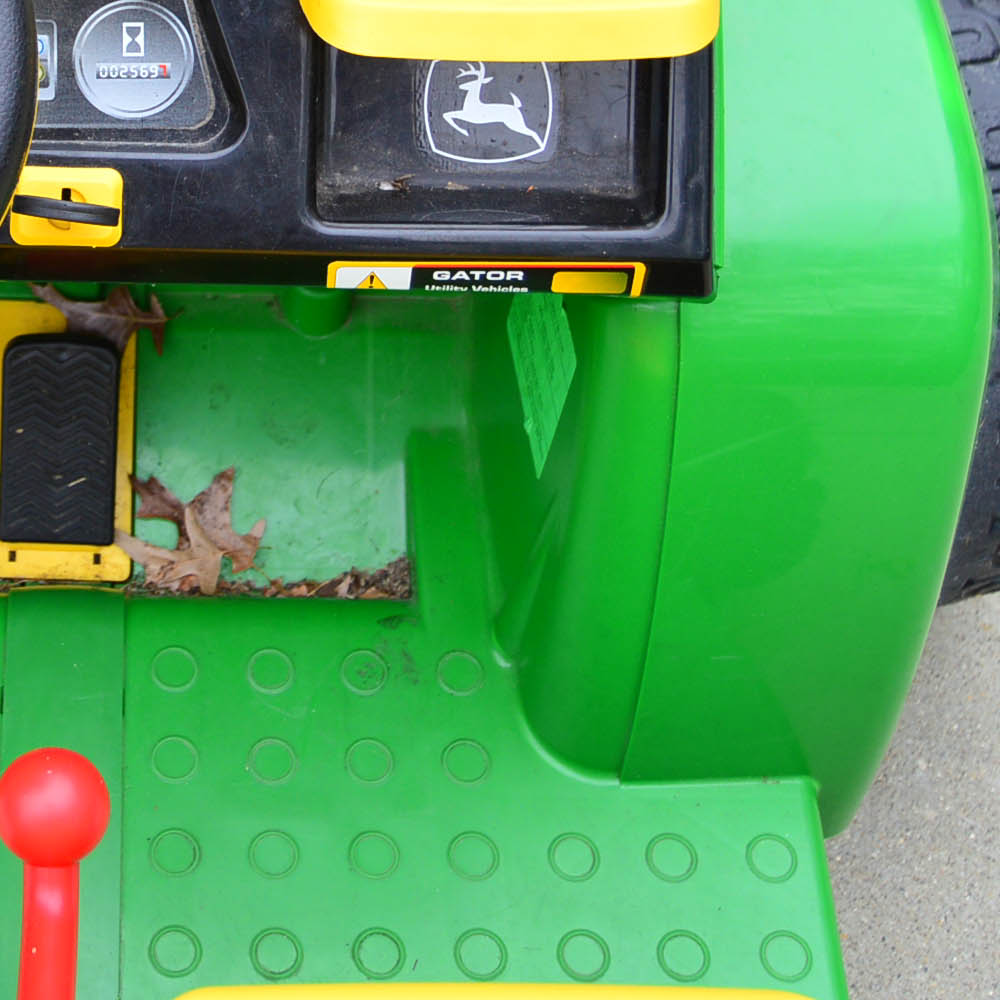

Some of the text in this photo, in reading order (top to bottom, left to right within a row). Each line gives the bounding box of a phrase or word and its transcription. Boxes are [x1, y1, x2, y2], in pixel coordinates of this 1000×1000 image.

[432, 270, 525, 281] GATOR
[424, 284, 529, 293] Utility Vehicles
